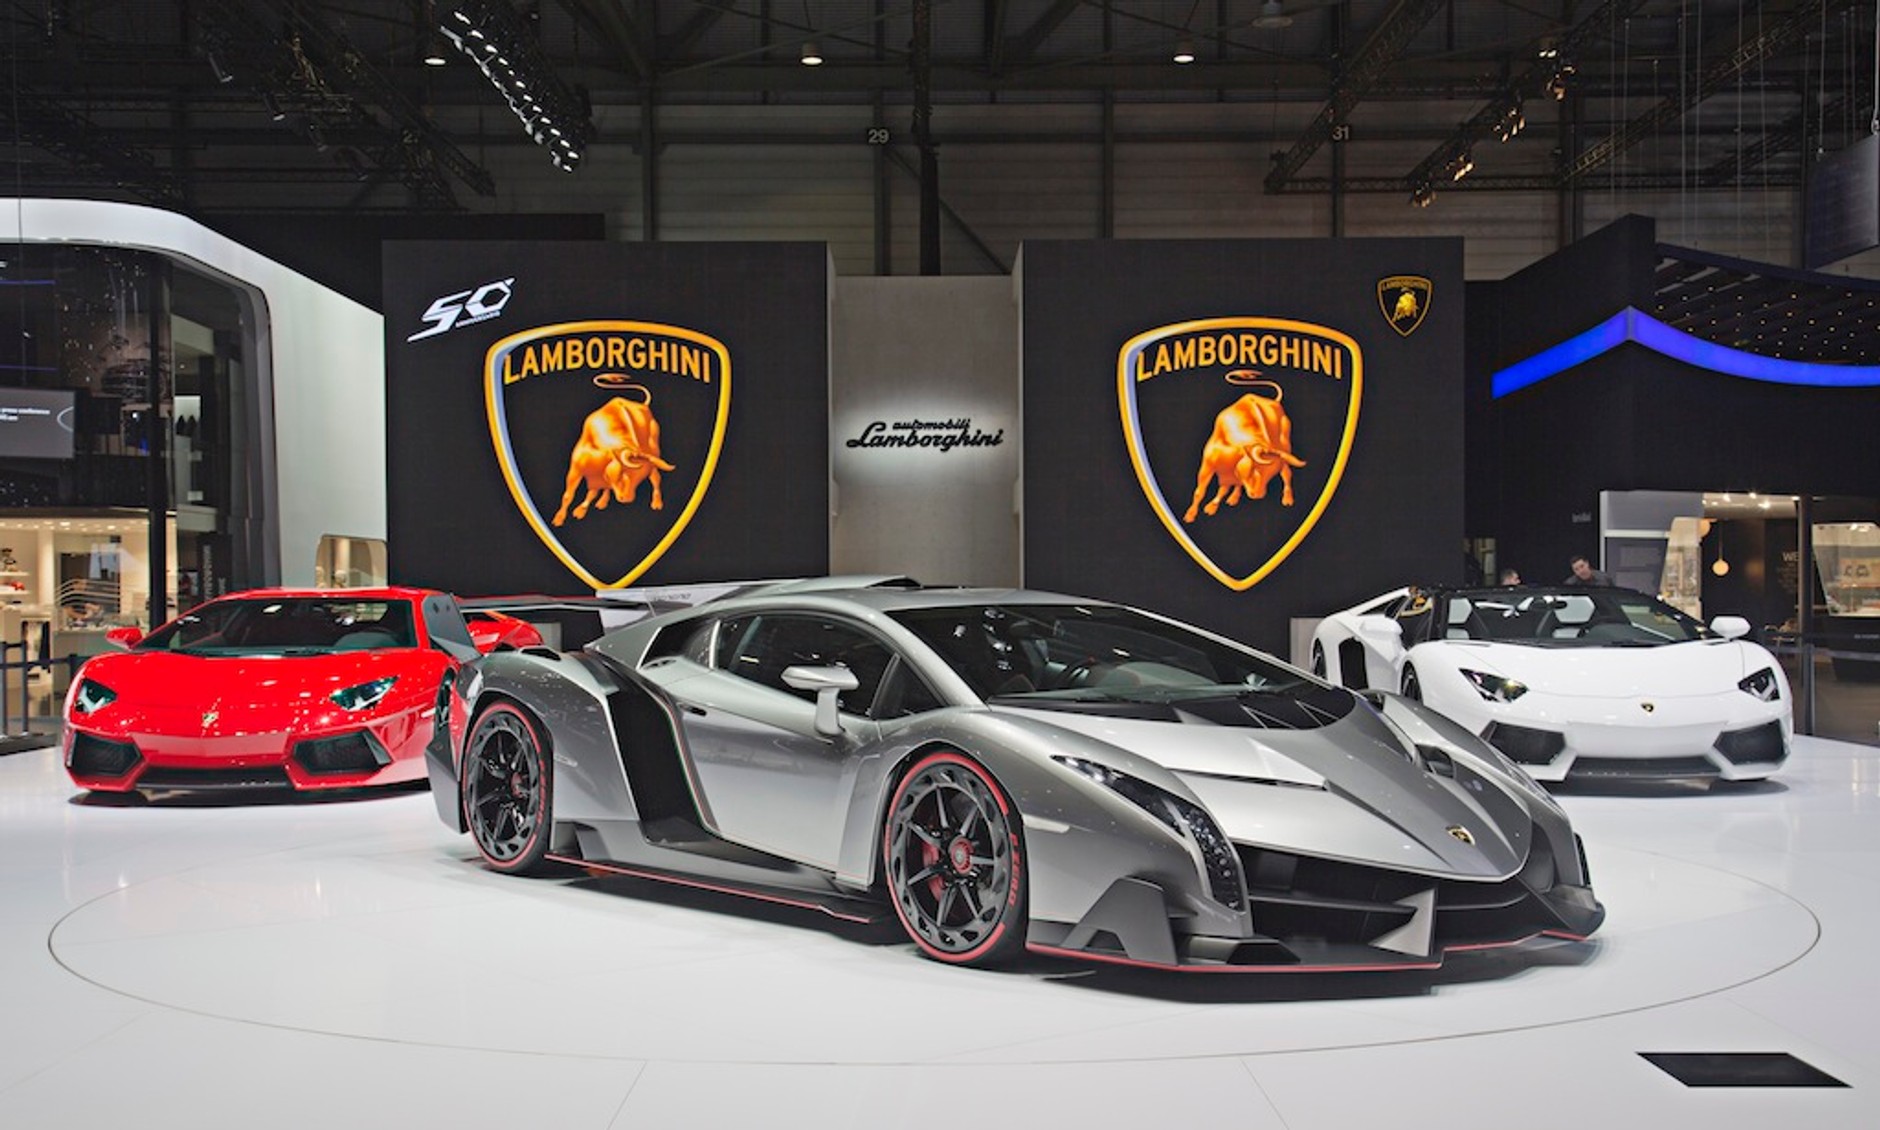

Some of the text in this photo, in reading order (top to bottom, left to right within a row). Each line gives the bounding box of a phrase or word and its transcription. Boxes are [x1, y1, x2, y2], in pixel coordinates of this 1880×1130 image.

[868, 129, 889, 143] 29
[1332, 126, 1349, 140] 31
[504, 337, 710, 385] LAMBORGHINI
[1137, 334, 1342, 382] LAMBORGHINI
[892, 418, 971, 430] automobili
[846, 421, 1004, 452] Lamborghini
